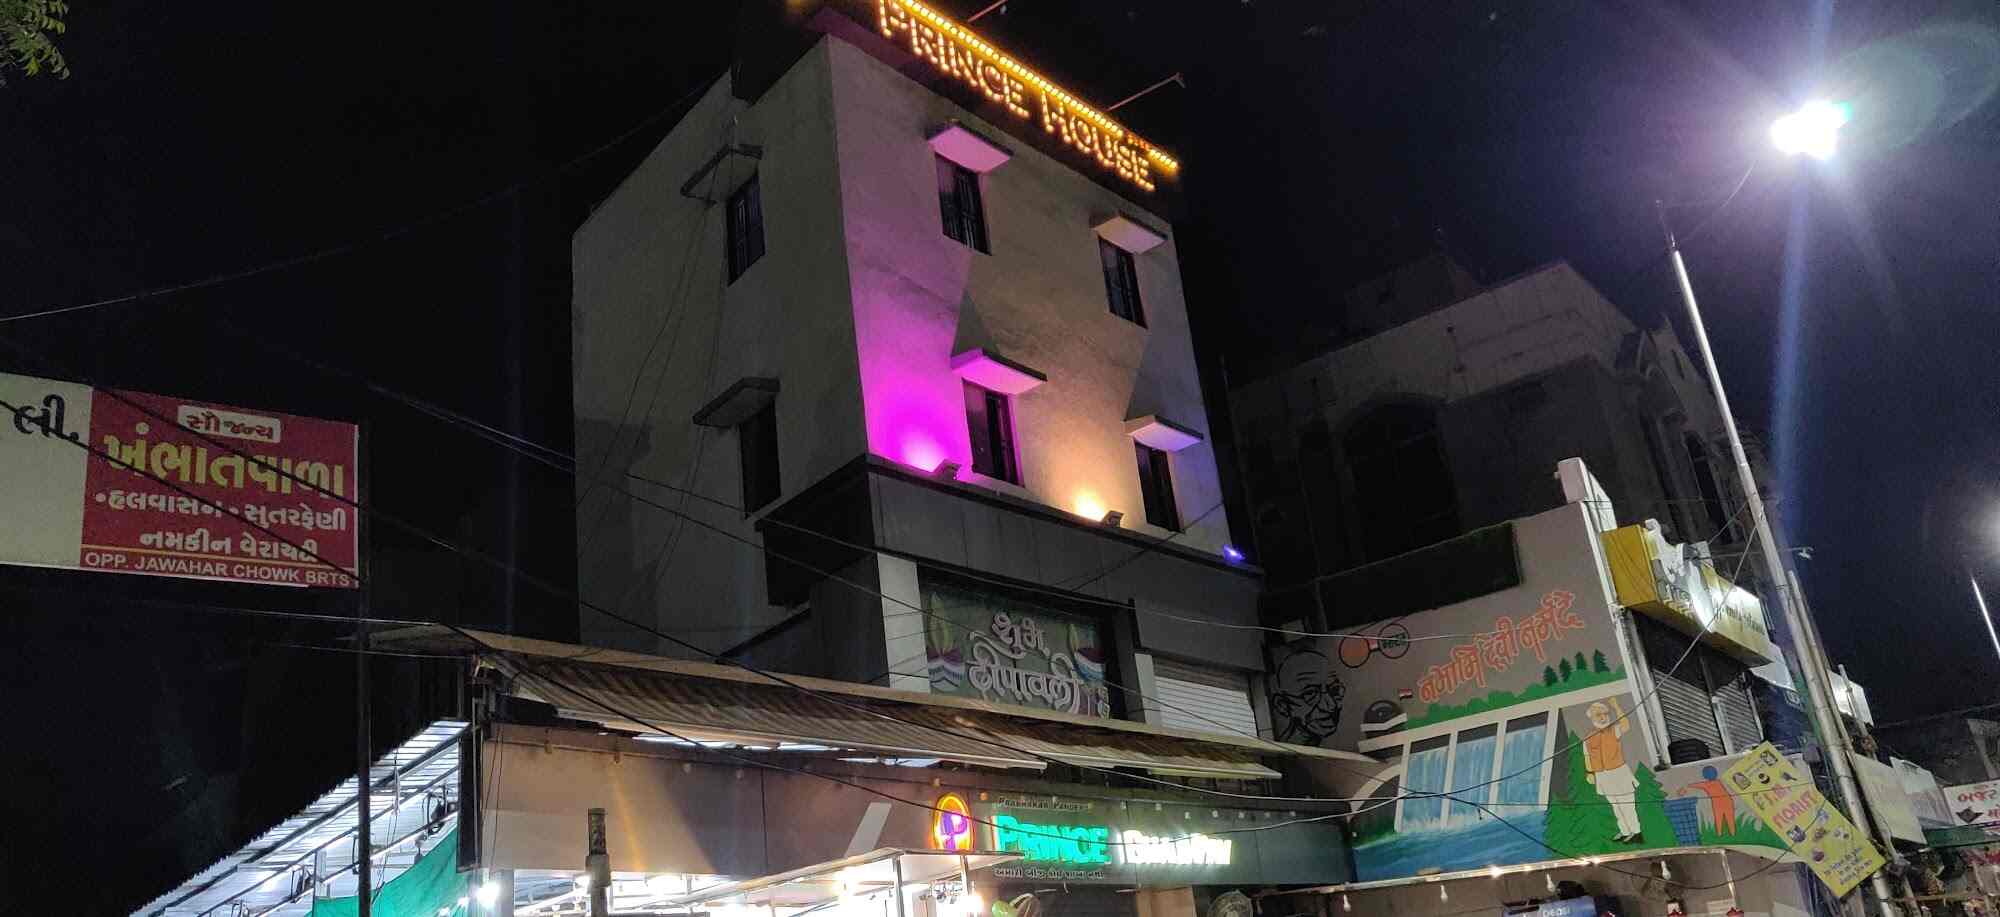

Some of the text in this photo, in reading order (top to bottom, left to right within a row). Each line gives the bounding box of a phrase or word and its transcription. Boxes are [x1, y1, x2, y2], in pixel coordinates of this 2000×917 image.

[879, 0, 1156, 191] PRINCE HOUSE
[104, 422, 345, 499] ખંભાતવાળા
[140, 527, 232, 555] નમકીન
[85, 552, 350, 587] OPP. JAWAHAR CHOWK BRTS
[993, 815, 1112, 864] PRINCE
